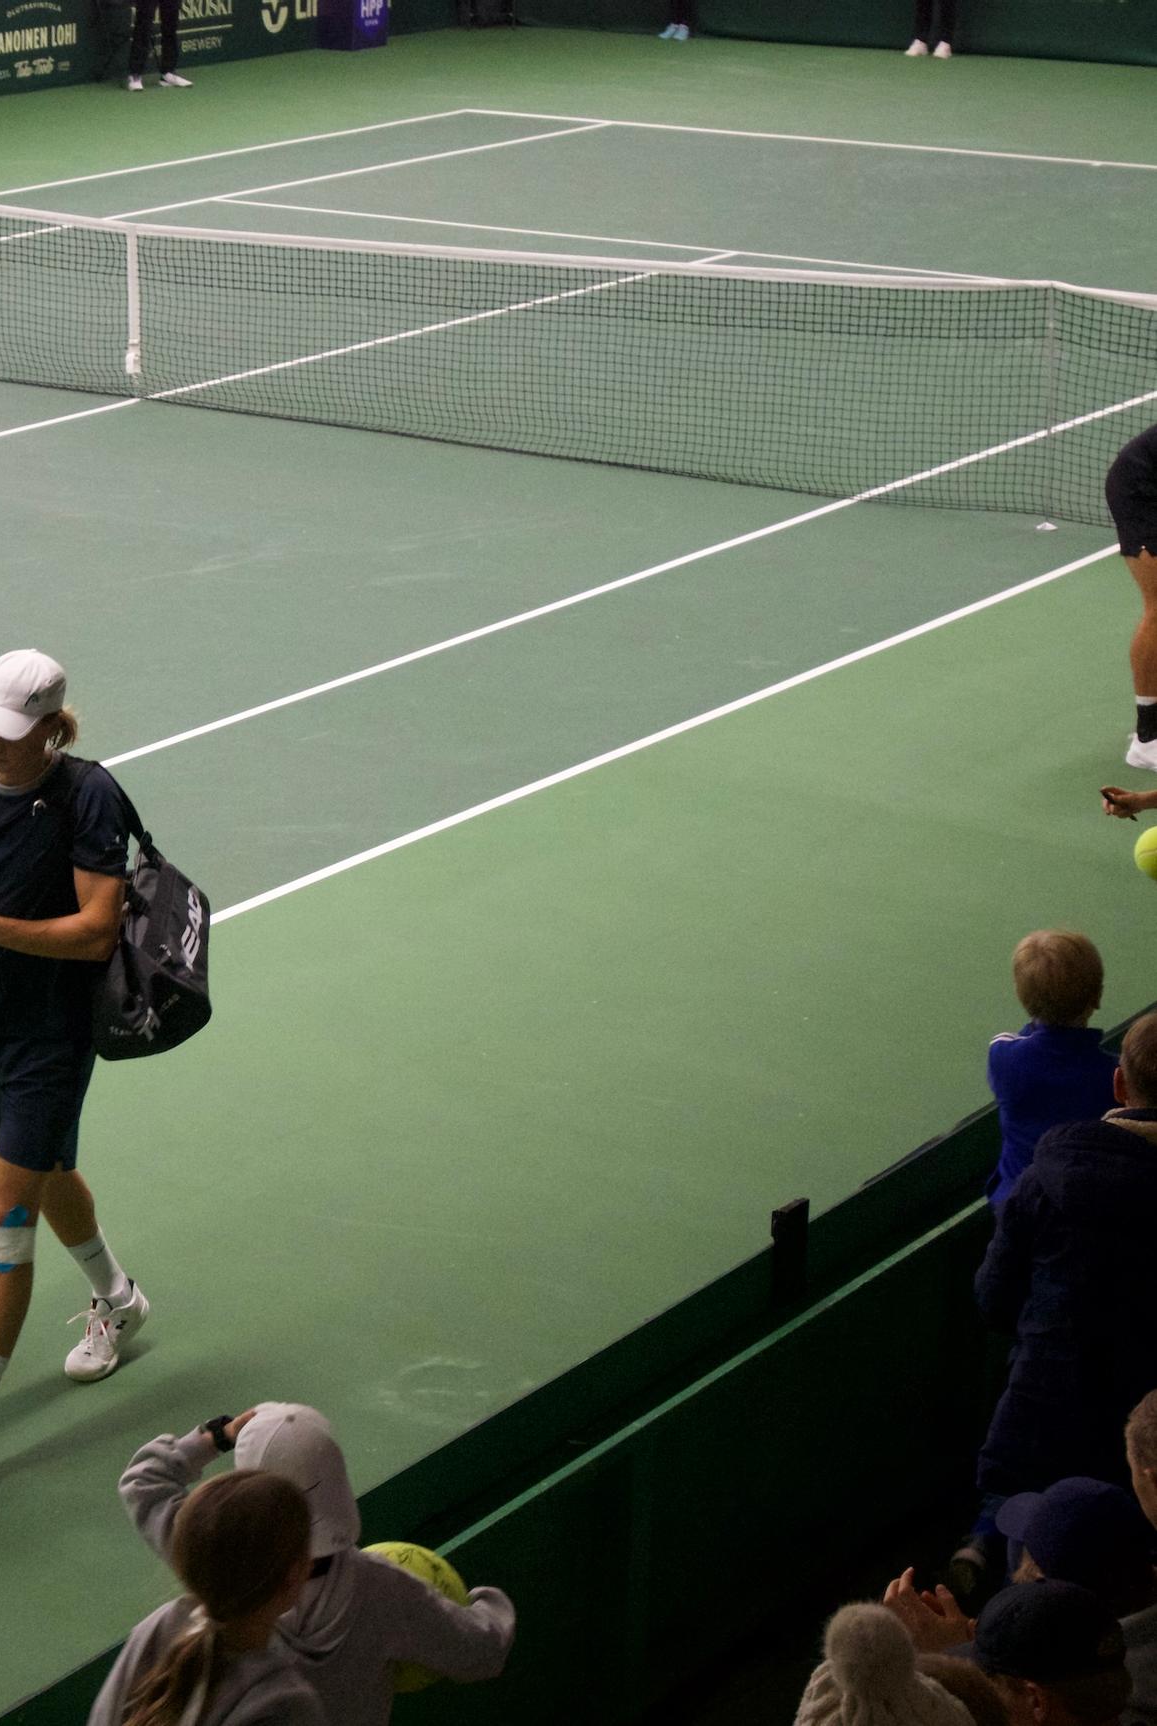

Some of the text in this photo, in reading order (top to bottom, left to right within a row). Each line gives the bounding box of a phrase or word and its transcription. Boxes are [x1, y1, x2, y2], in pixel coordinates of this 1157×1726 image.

[360, 0, 383, 18] HPP
[51, 23, 77, 47] LOHI
[181, 885, 203, 973] EAD
